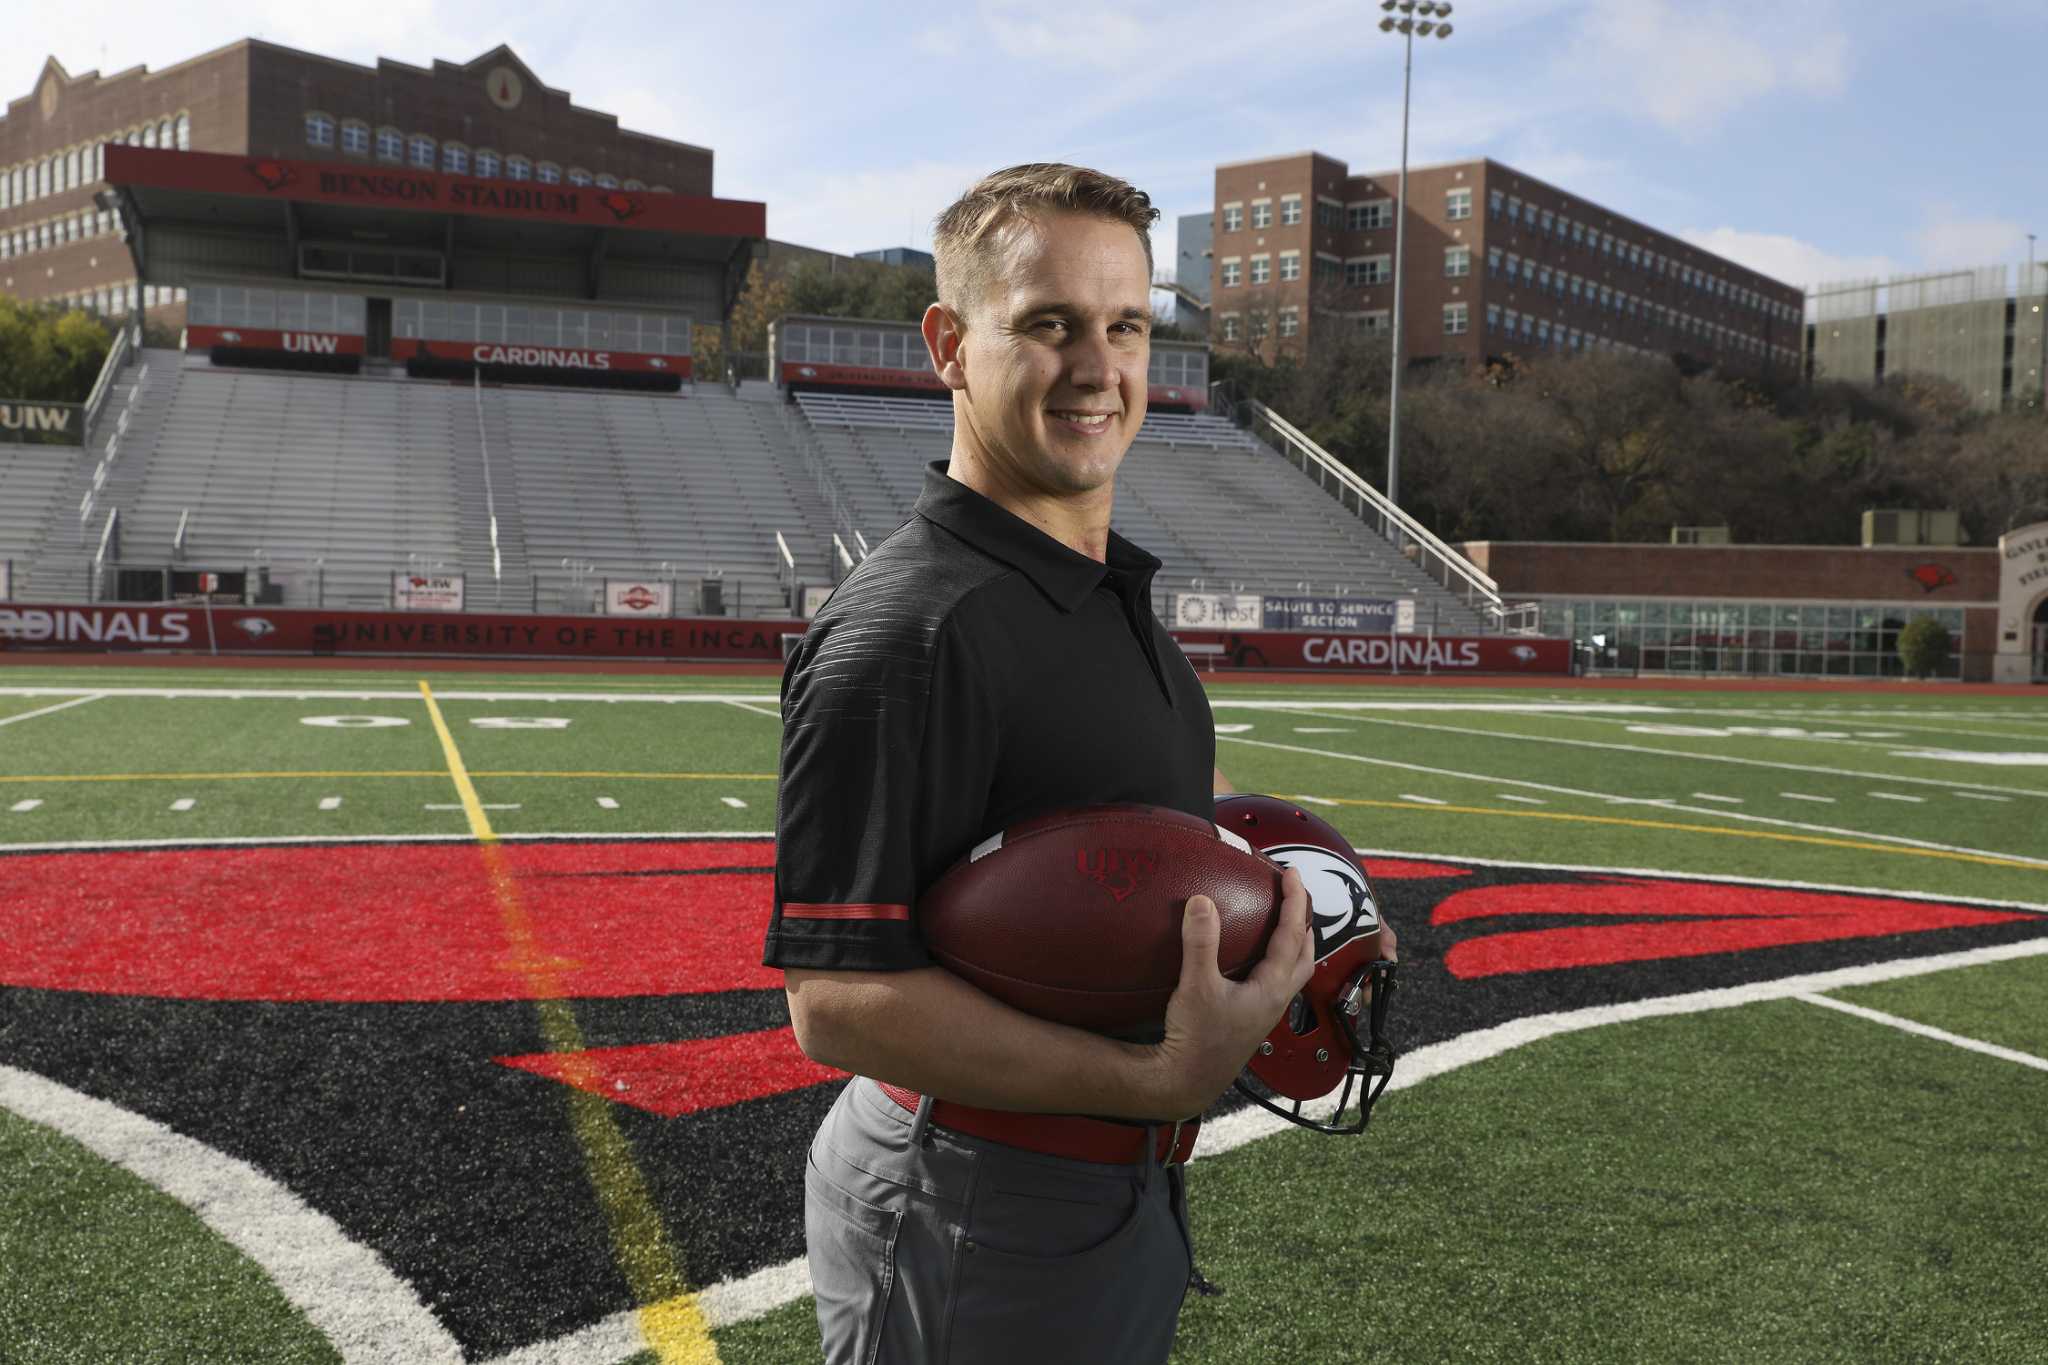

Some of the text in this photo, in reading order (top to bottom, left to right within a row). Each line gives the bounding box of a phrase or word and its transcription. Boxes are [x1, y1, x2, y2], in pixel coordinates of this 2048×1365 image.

[320, 173, 577, 214] BENSON STADIUM
[282, 333, 338, 354] UIW
[473, 345, 609, 371] CARDINALS
[1, 405, 70, 431] UIW
[1211, 602, 1257, 622] Frost
[1265, 601, 1393, 616] SALUTE TO SERVICE
[1301, 615, 1358, 628] SECTION
[557, 626, 599, 646] OF
[613, 628, 674, 648] THE
[1303, 638, 1480, 666] CARDINALS
